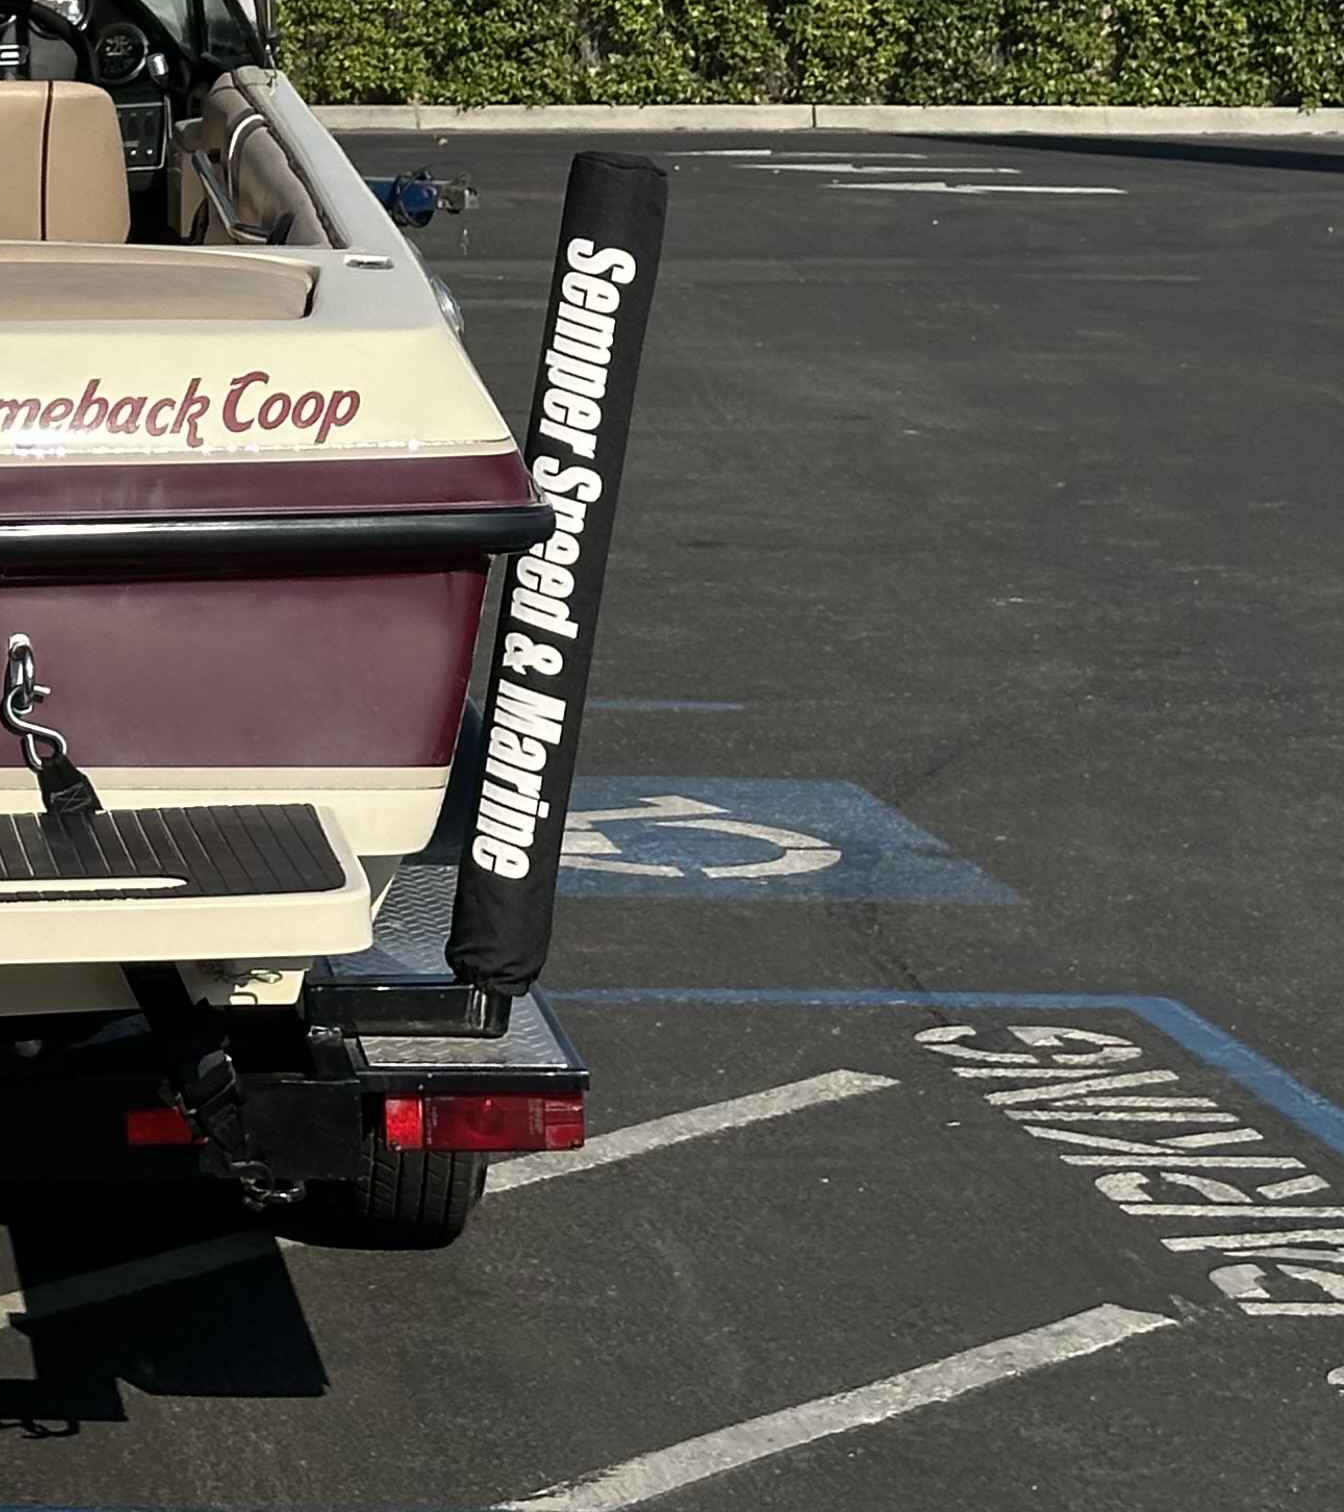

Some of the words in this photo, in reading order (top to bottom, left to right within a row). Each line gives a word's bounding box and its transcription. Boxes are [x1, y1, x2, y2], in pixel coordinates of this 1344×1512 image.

[222, 370, 362, 445] Coop
[539, 237, 637, 461] Semper
[502, 631, 564, 676] &
[471, 678, 567, 881] Marine
